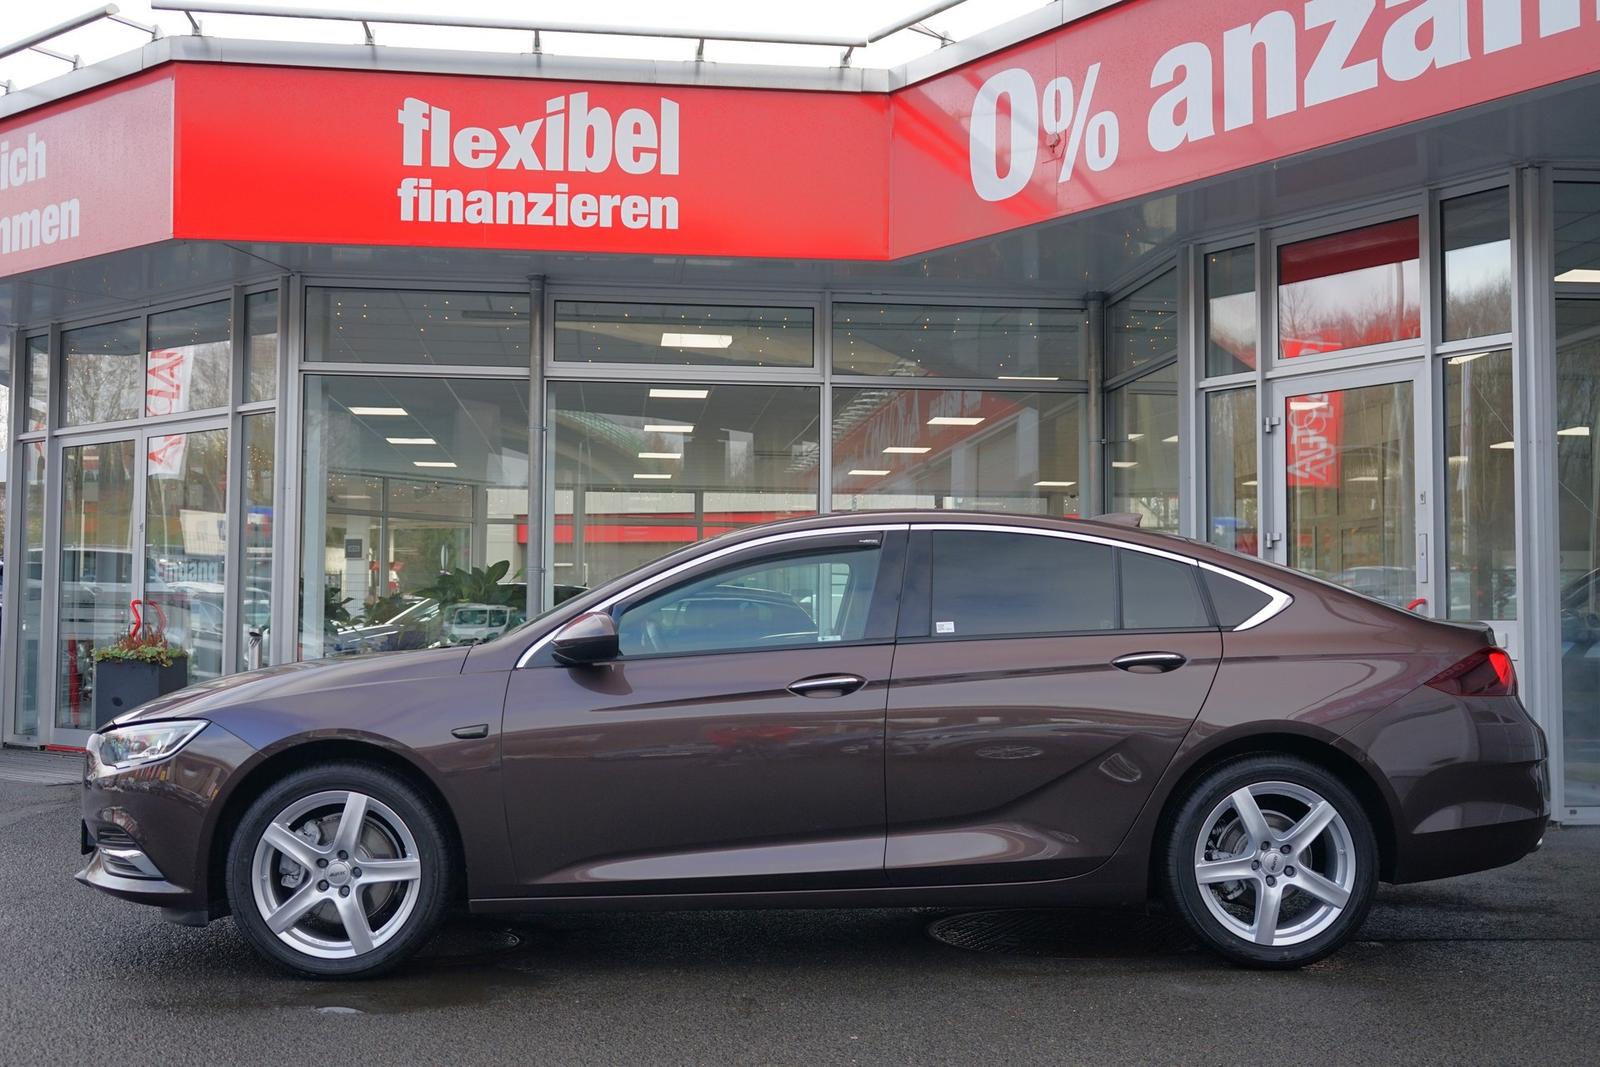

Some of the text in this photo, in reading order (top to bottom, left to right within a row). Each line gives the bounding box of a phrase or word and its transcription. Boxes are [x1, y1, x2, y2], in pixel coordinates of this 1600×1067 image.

[397, 91, 680, 176] flexibel
[969, 0, 1600, 203] 0% anza
[397, 178, 680, 230] finanzieren
